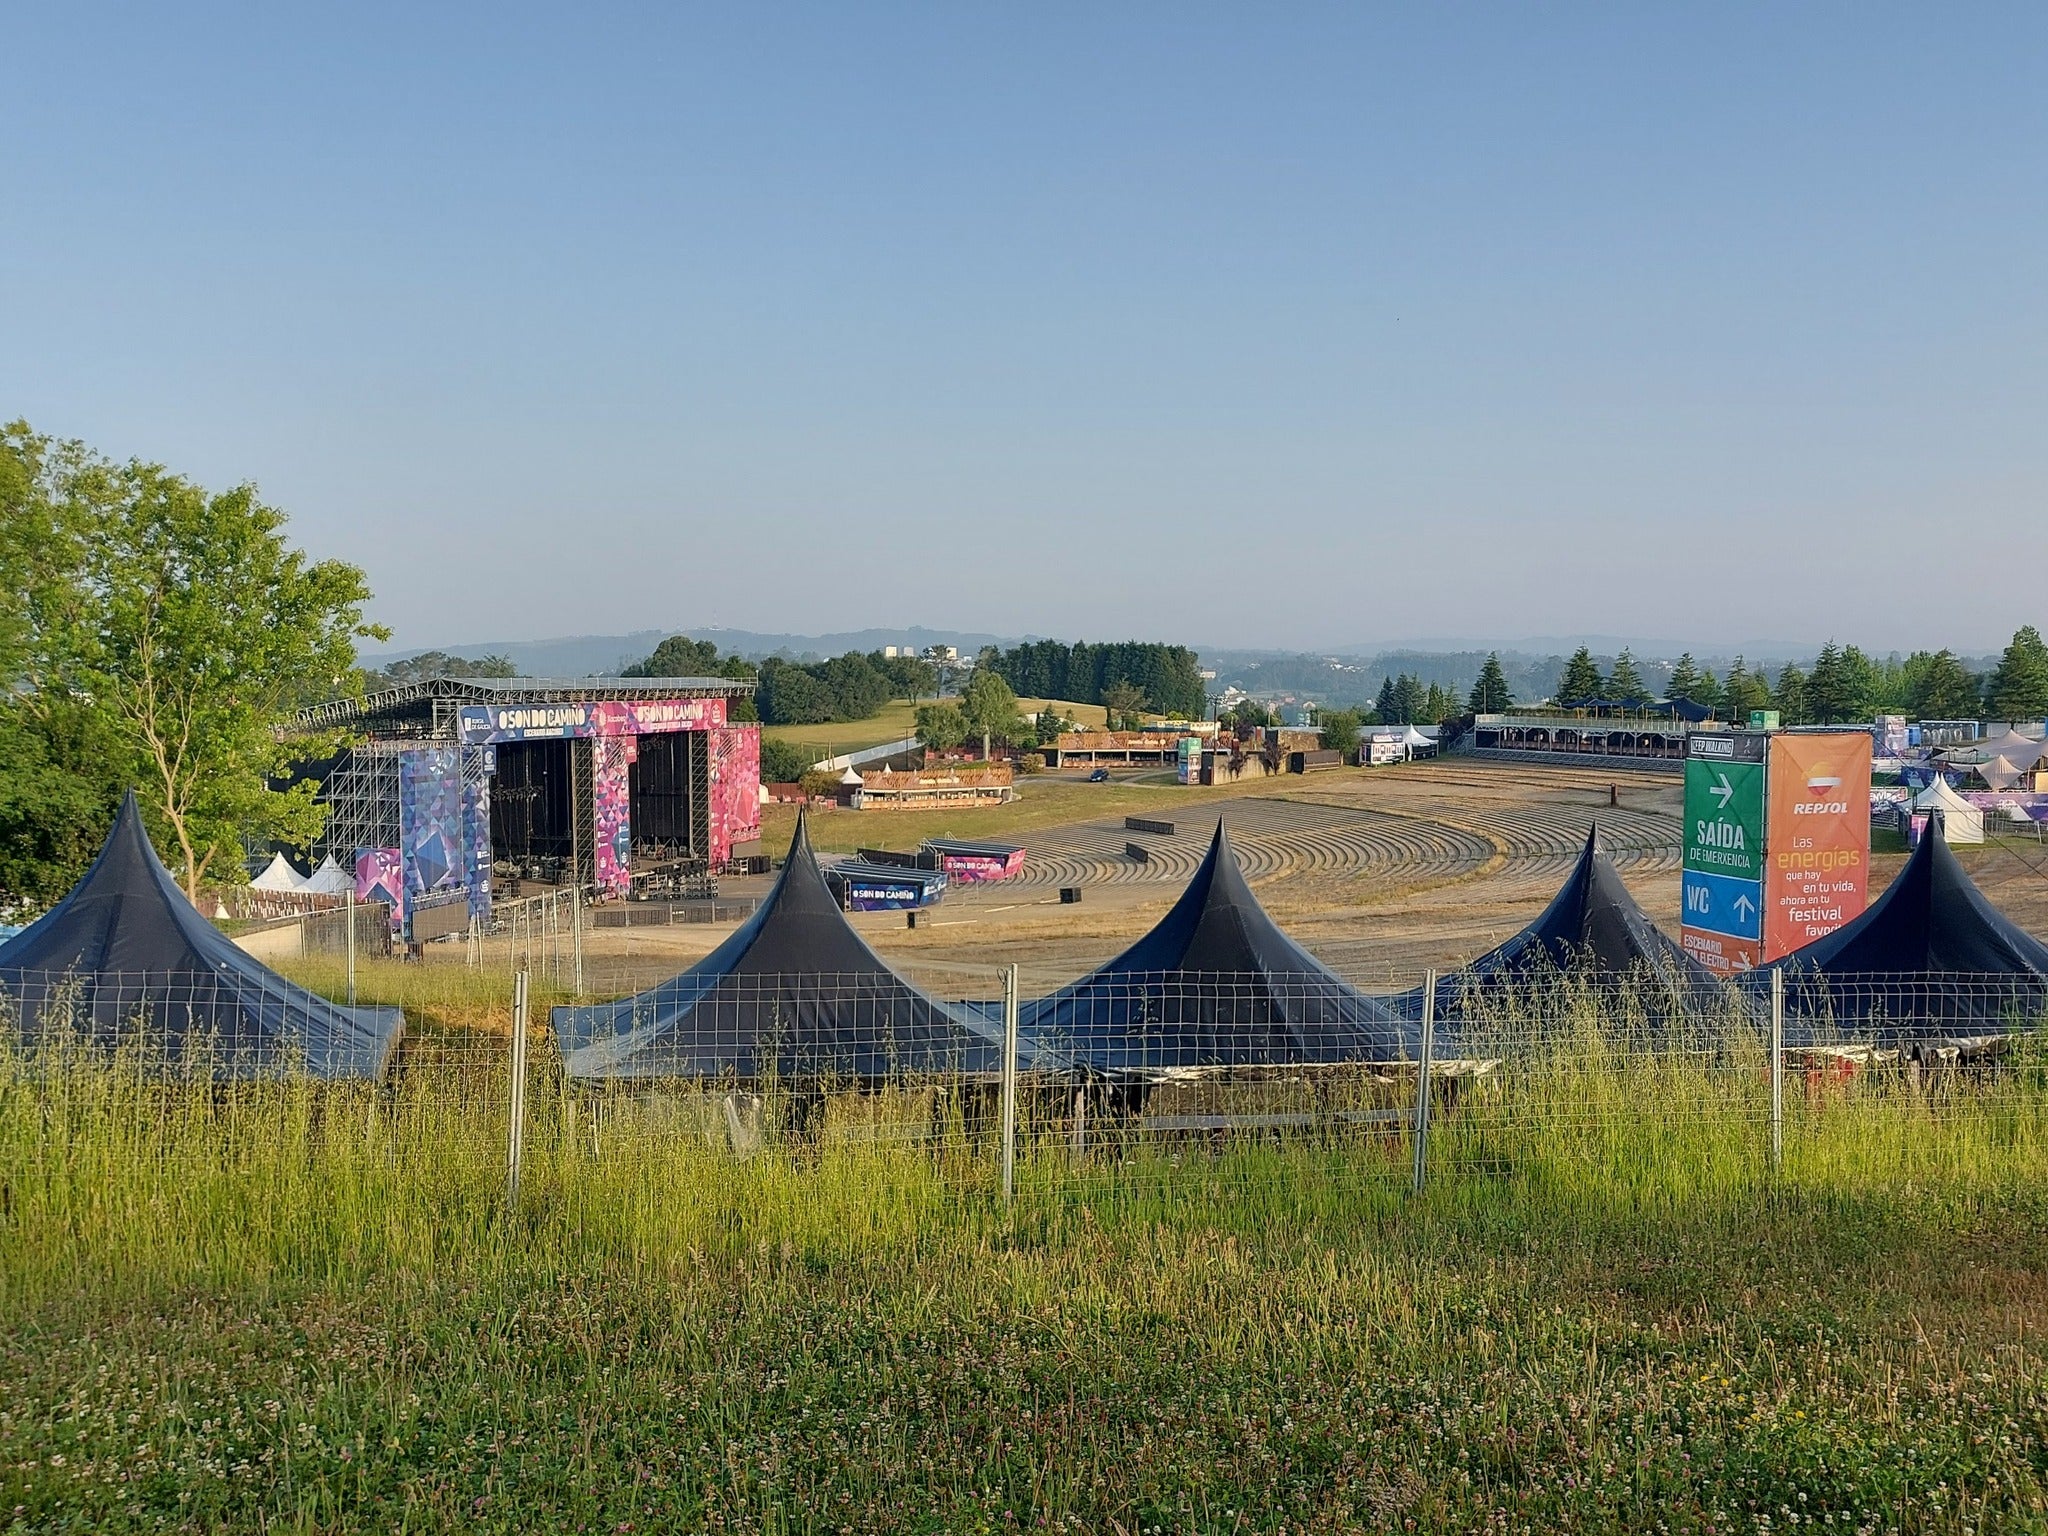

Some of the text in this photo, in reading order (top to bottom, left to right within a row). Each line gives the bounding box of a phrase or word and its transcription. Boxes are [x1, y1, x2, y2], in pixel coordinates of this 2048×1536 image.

[499, 704, 586, 729] O SON DO CAMIÑO
[645, 705, 661, 722] SON
[1706, 741, 1732, 754] WALKING
[1794, 801, 1848, 814] REPSOL
[1697, 817, 1745, 850] SAÍDA
[1793, 837, 1813, 848] Las
[1690, 847, 1750, 868] DE EMERXENCIA
[1778, 846, 1860, 872] energías
[1786, 870, 1822, 882] que hay
[853, 889, 858, 898] O
[859, 889, 874, 898] SON
[875, 889, 885, 899] DO
[1803, 881, 1857, 893] en tu vida,
[1687, 884, 1710, 914] WC
[1780, 894, 1830, 906] ahora en tu
[1788, 905, 1843, 922] festival
[1806, 923, 1842, 937] favori
[1685, 934, 1722, 955] ESCENARIO
[1700, 951, 1730, 970] ELECTRO
